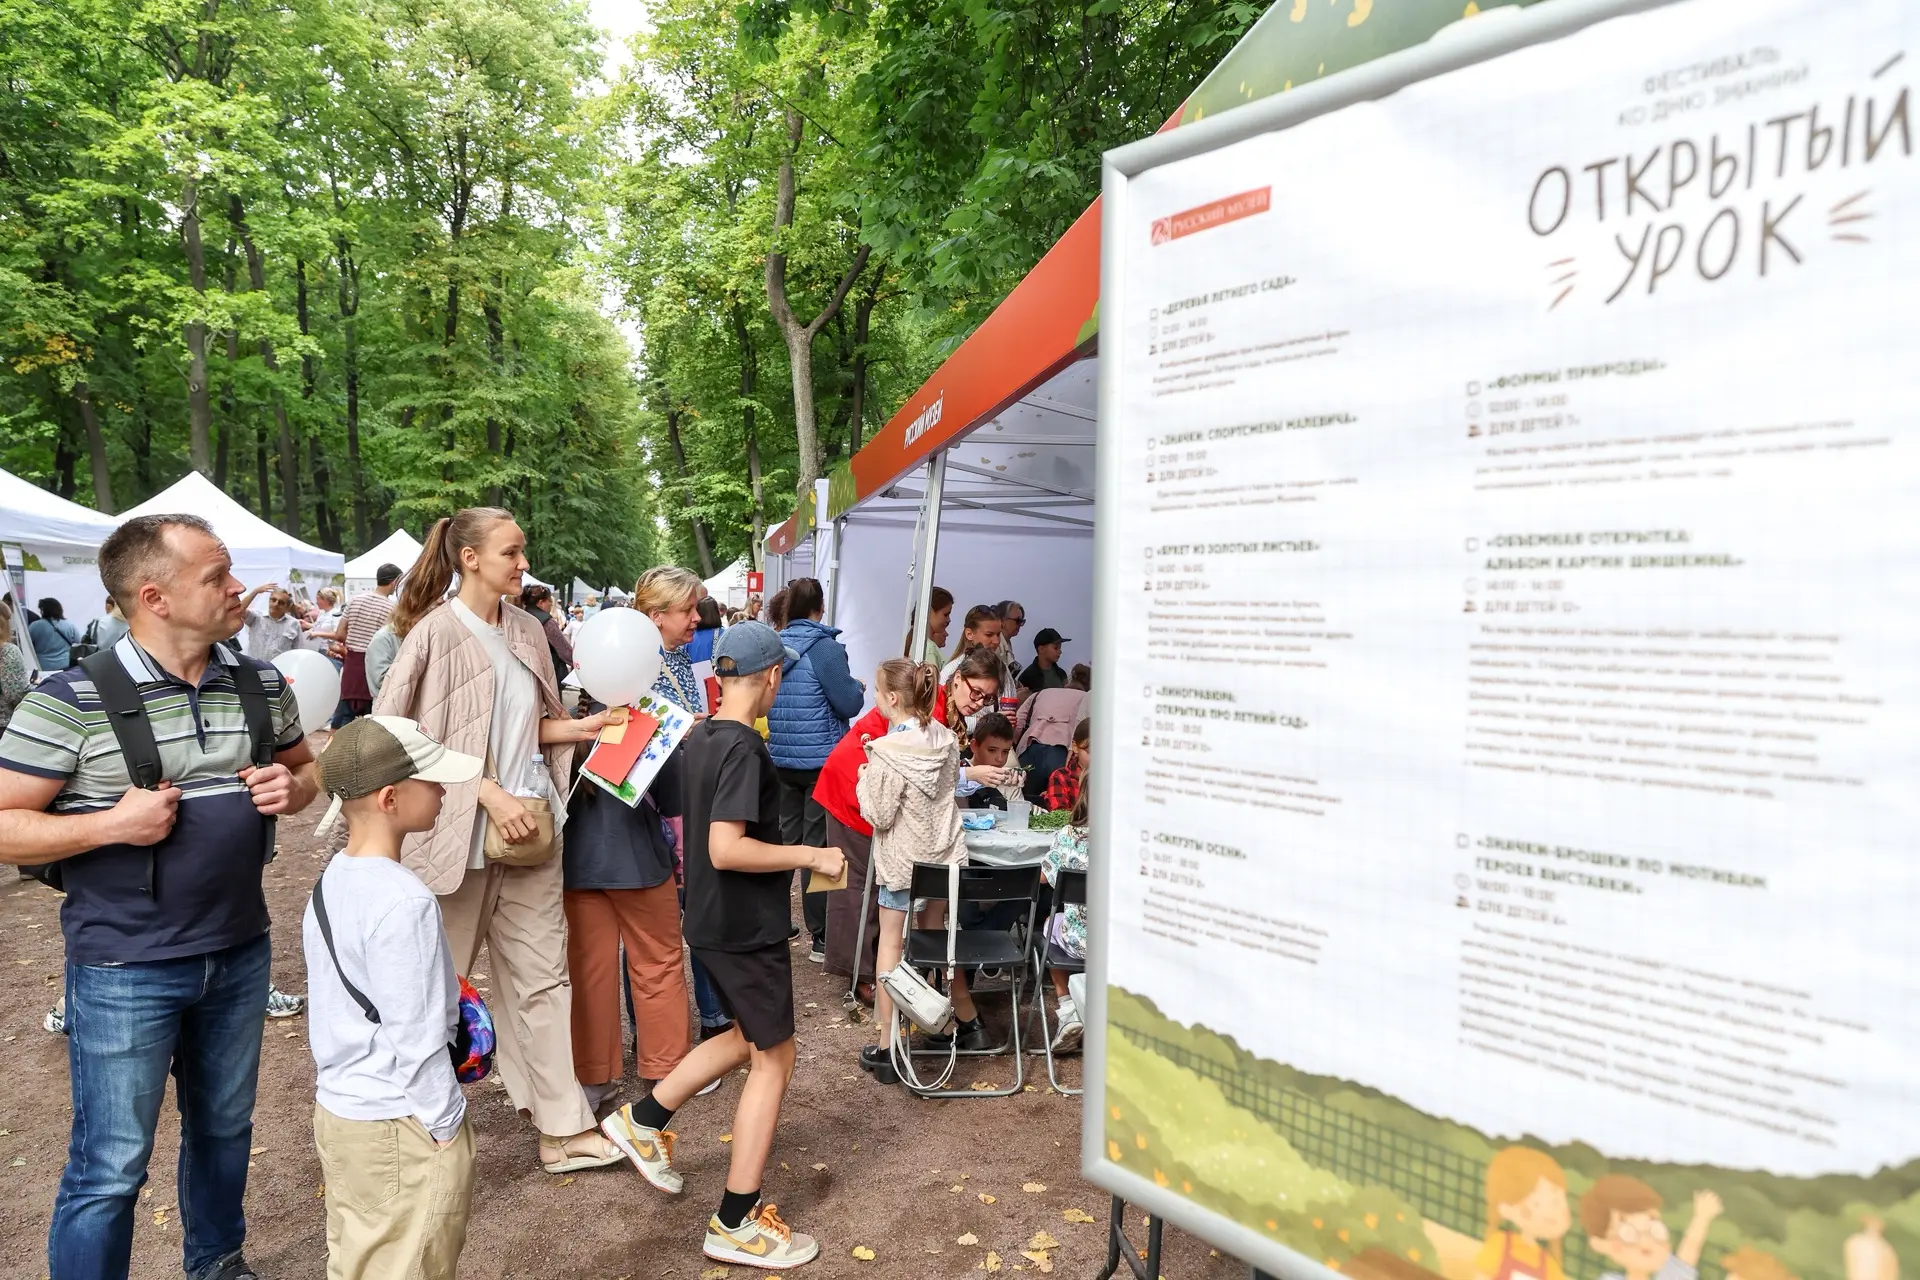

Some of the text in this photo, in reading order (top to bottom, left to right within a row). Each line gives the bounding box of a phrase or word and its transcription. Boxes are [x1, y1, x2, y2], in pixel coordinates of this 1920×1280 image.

[1618, 105, 1646, 125] КО
[1651, 91, 1706, 121] ДНЮ
[1643, 47, 1780, 94] ФЕСТИВАЛЬ
[1528, 51, 1912, 237] ОТКРЫТЫЙ
[1605, 193, 1804, 305] УРОК
